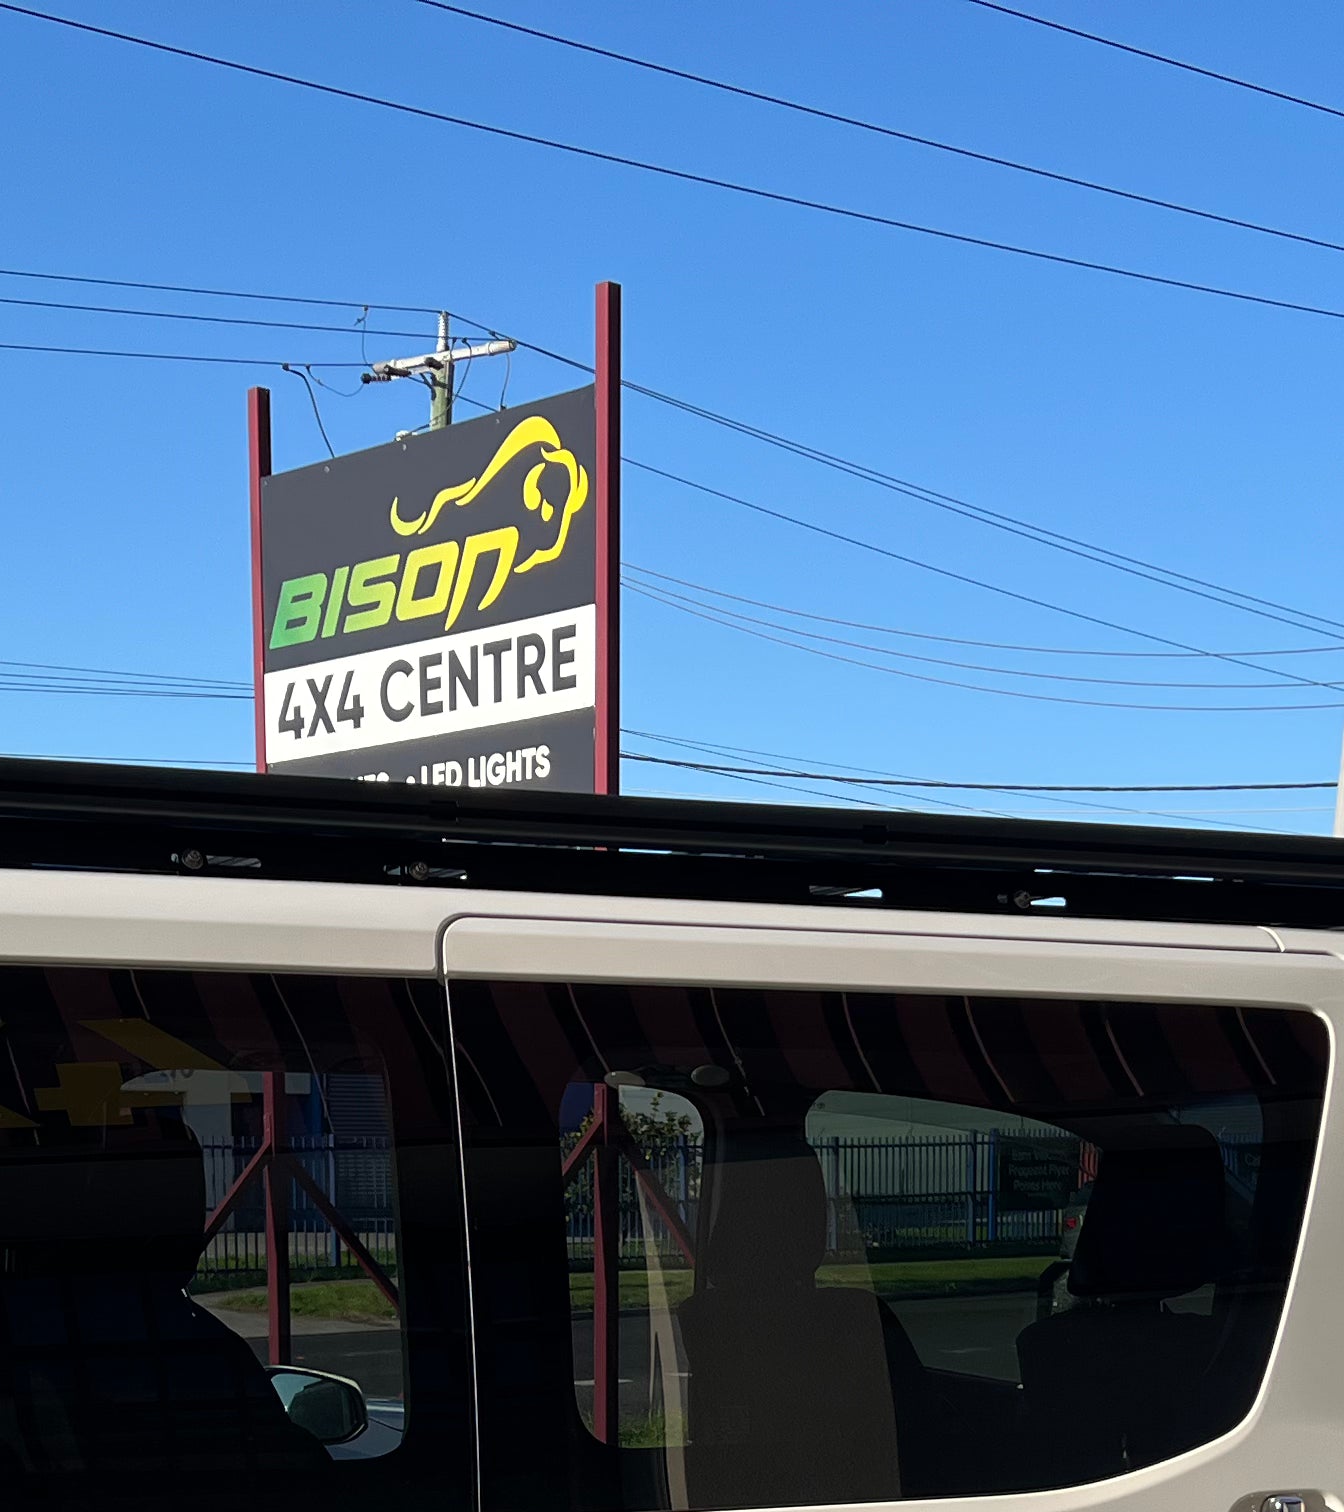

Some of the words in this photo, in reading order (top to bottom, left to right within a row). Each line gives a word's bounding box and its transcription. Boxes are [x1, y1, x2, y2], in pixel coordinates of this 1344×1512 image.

[269, 526, 519, 649] BISON
[278, 669, 364, 740] 4X4
[380, 623, 577, 722] CENTRE
[468, 745, 551, 788] LIGHTS
